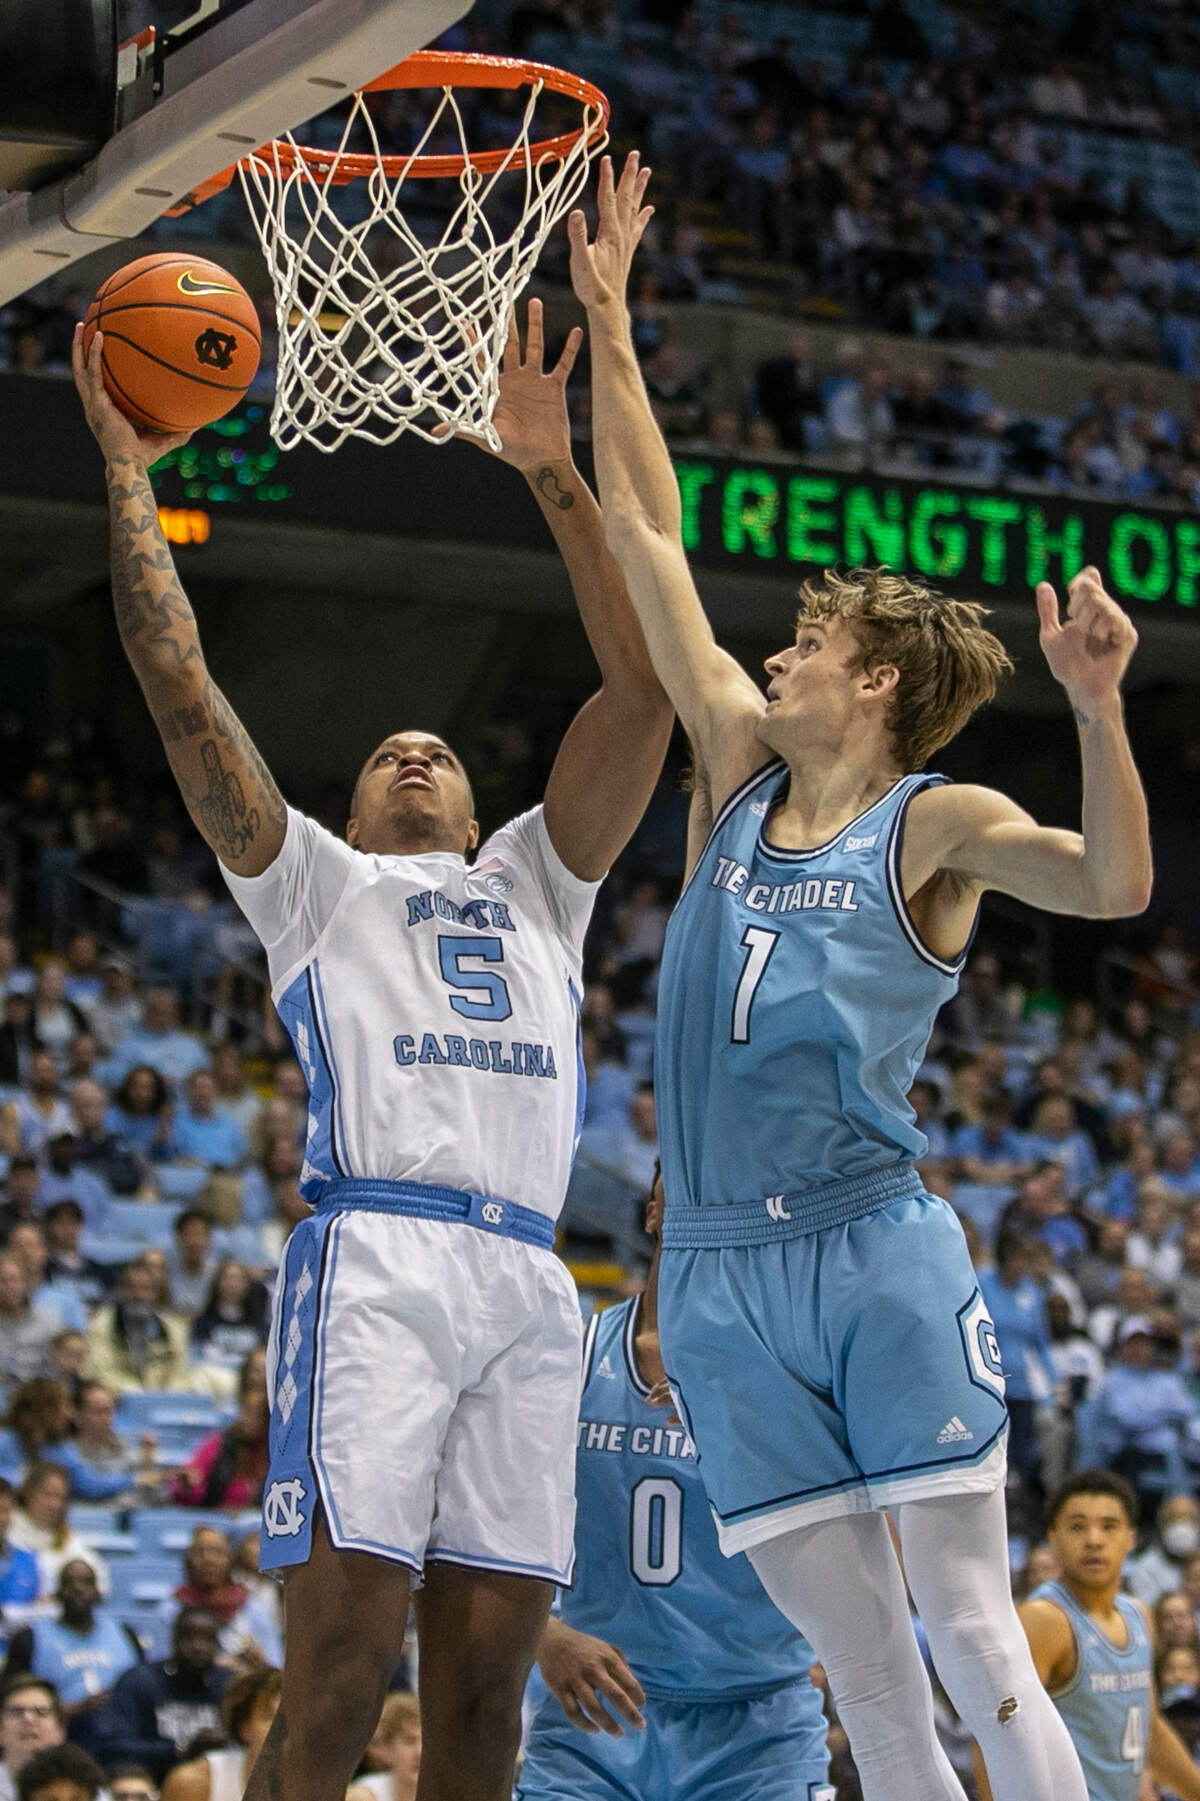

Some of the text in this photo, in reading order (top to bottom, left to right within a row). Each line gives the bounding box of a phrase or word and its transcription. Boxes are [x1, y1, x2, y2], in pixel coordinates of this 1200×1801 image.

[674, 461, 1084, 588] TRENGTH
[405, 889, 517, 932] NORTH
[744, 878, 860, 914] CITADEL
[437, 934, 513, 1022] 5
[730, 923, 782, 1045] 1
[393, 1032, 558, 1080] CAROLINA
[576, 1420, 698, 1460] THE CITA
[936, 1430, 974, 1445] adidas
[630, 1475, 686, 1588] 0
[1121, 1705, 1145, 1777] 4
